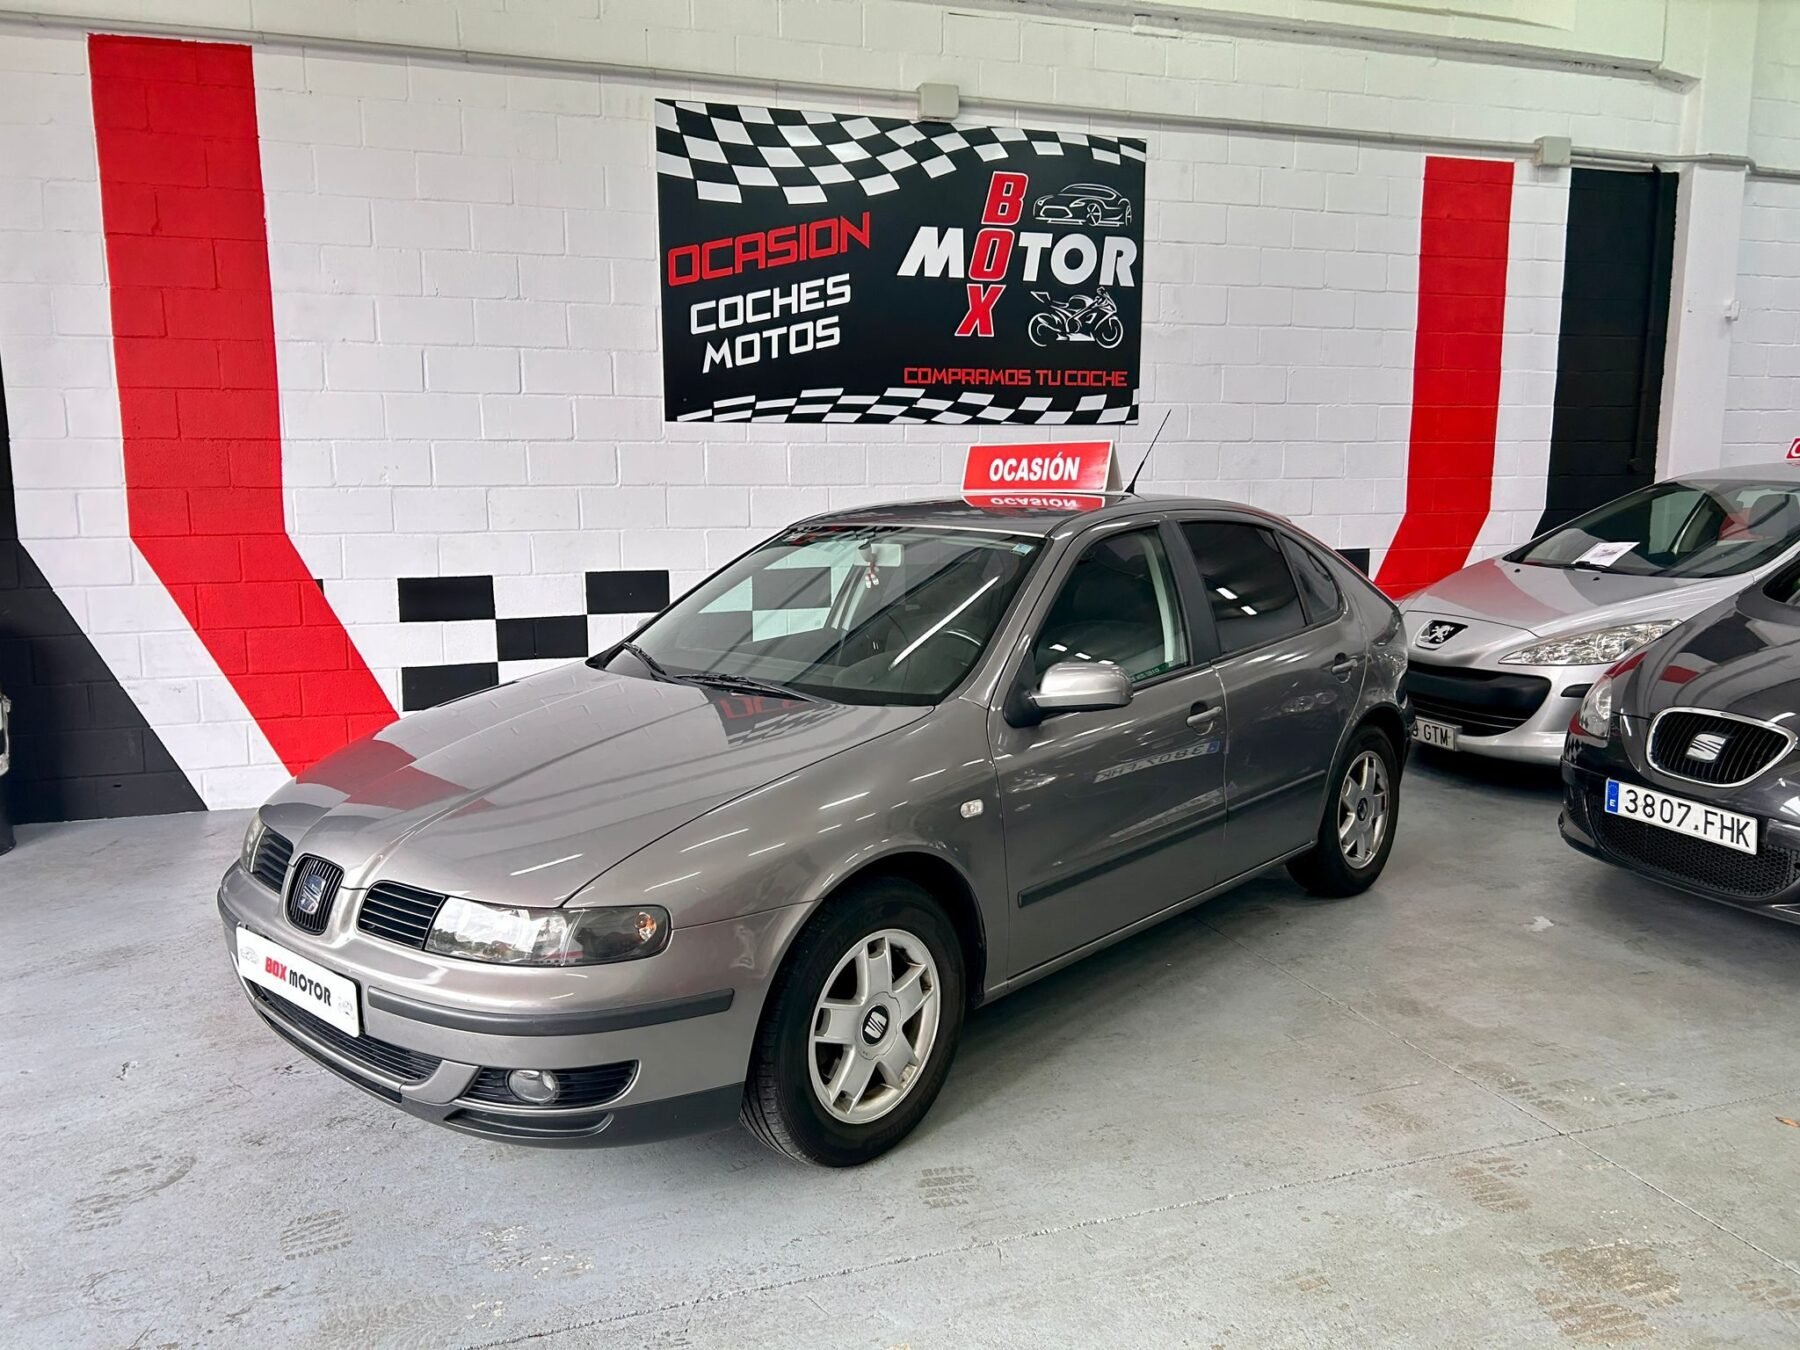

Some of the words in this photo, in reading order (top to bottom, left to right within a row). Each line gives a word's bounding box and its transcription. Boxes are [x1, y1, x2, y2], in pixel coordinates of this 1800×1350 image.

[667, 211, 870, 287] OCASION
[897, 226, 1138, 287] MOTOR
[955, 171, 1028, 337] BOX
[690, 273, 851, 335] COCHES
[702, 315, 840, 374] MOTOS
[904, 367, 1031, 385] COMPRAMOS
[1035, 370, 1061, 386] TU
[1064, 370, 1128, 387] COCHE
[989, 451, 1081, 482] OCASIÓN
[1423, 724, 1448, 746] GTM
[1609, 799, 1616, 807] E
[1624, 789, 1691, 828] 3807
[1703, 809, 1751, 848] FHK
[264, 956, 287, 982] BOX
[289, 969, 332, 1007] MOTOR
